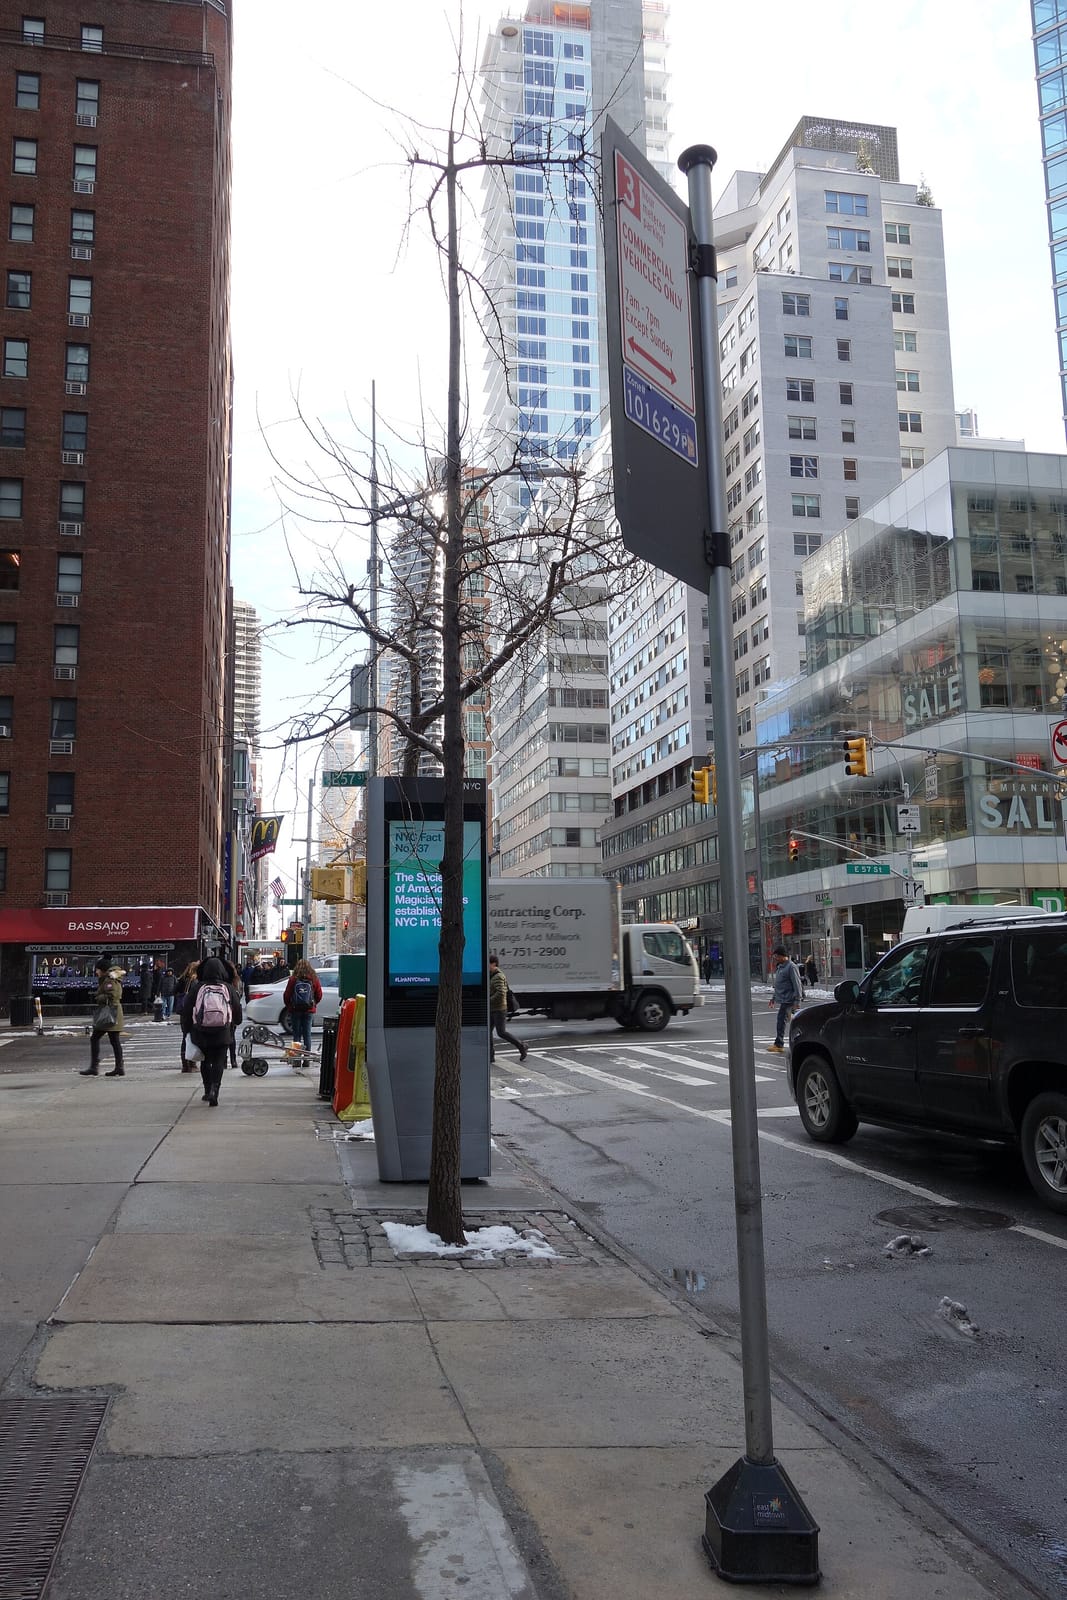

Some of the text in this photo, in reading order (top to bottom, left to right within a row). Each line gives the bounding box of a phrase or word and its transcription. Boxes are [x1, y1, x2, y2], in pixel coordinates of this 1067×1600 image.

[624, 167, 635, 209] 3
[643, 204, 666, 234] metered
[643, 218, 664, 248] parking
[622, 223, 674, 285] COMMERCIAL
[623, 243, 682, 312] VEHICLES ONLY
[646, 306, 660, 330] 7pm
[625, 306, 673, 360] Except Sunday
[628, 389, 680, 447] 101629
[904, 674, 962, 725] SALE
[341, 773, 355, 785] 57
[463, 782, 481, 790] NYC
[395, 832, 442, 842] NYC Fact
[395, 873, 414, 882] The
[395, 884, 405, 893] of
[553, 905, 586, 919] Corp.
[1037, 897, 1062, 912] TD
[68, 921, 130, 931] BASSANO
[395, 917, 418, 927] NYC
[420, 917, 429, 927] in
[524, 933, 542, 941] And
